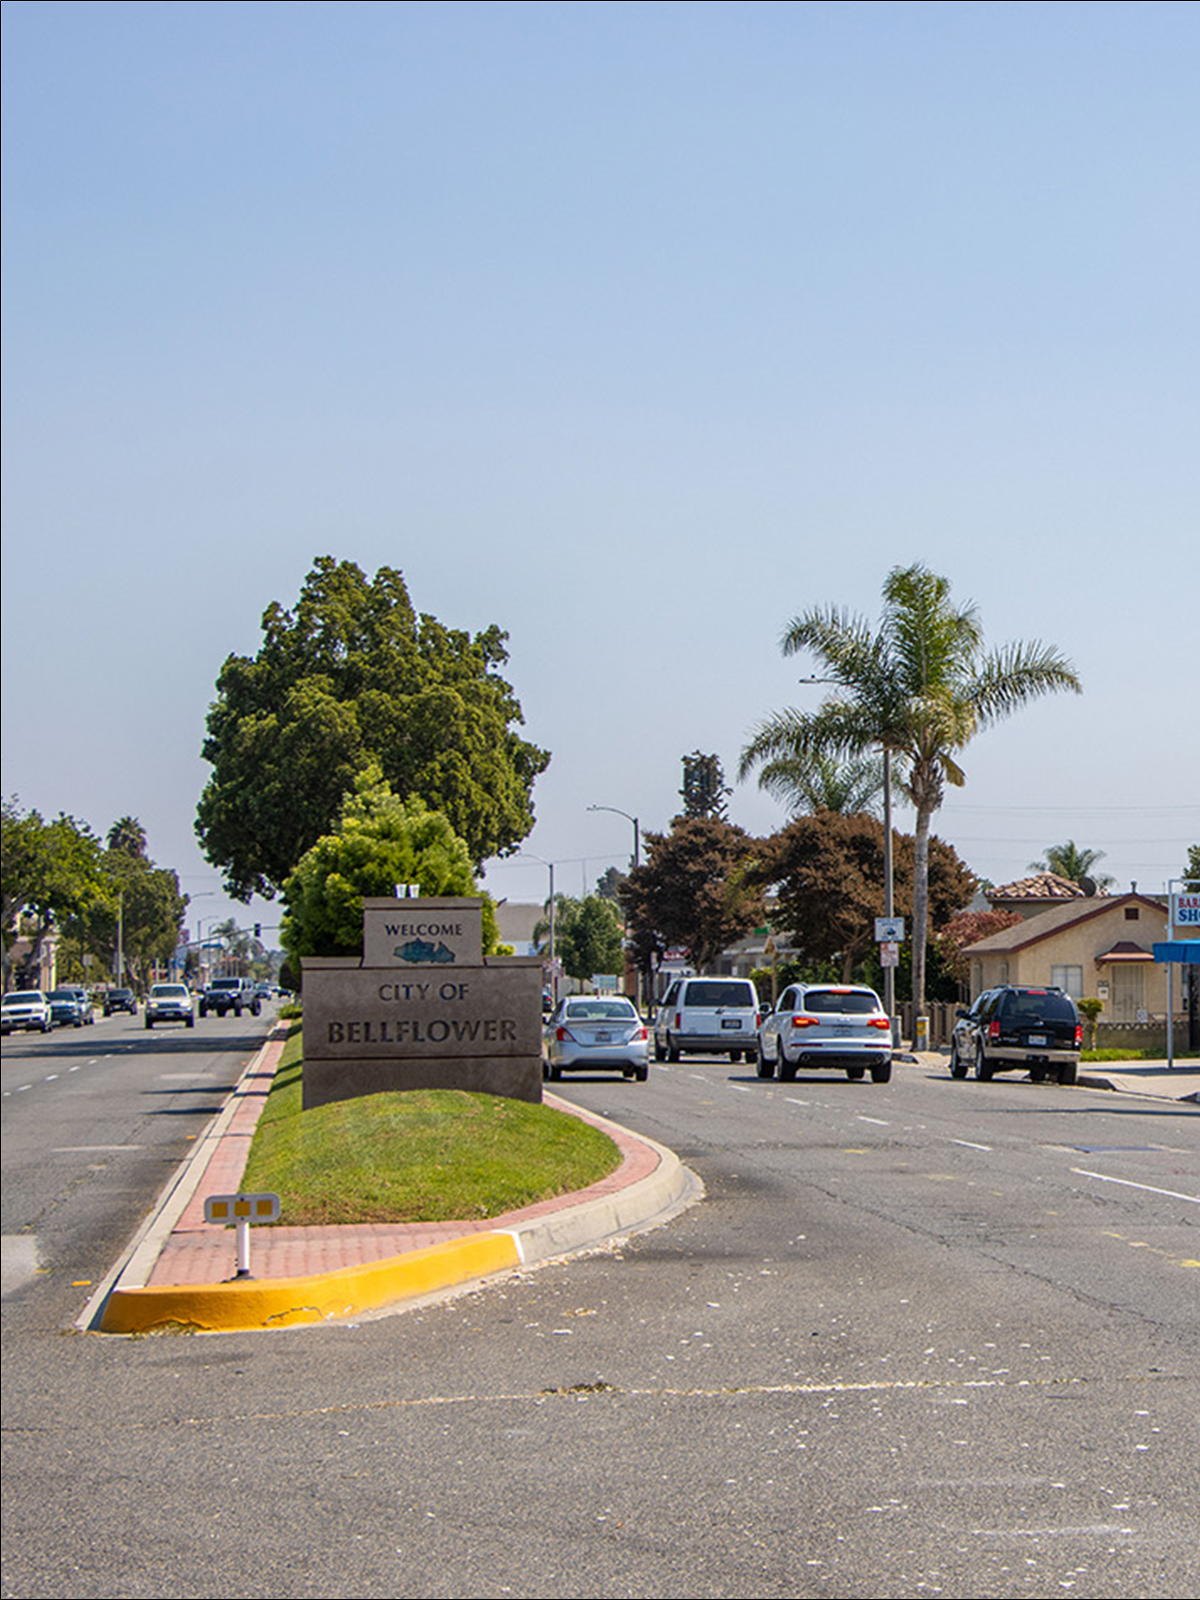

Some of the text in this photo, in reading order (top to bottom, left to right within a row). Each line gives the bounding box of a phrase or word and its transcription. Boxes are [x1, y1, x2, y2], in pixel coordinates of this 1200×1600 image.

[385, 924, 463, 936] WELCOME
[378, 982, 469, 1001] CITY OF
[328, 1019, 517, 1043] BELLFLOWER
